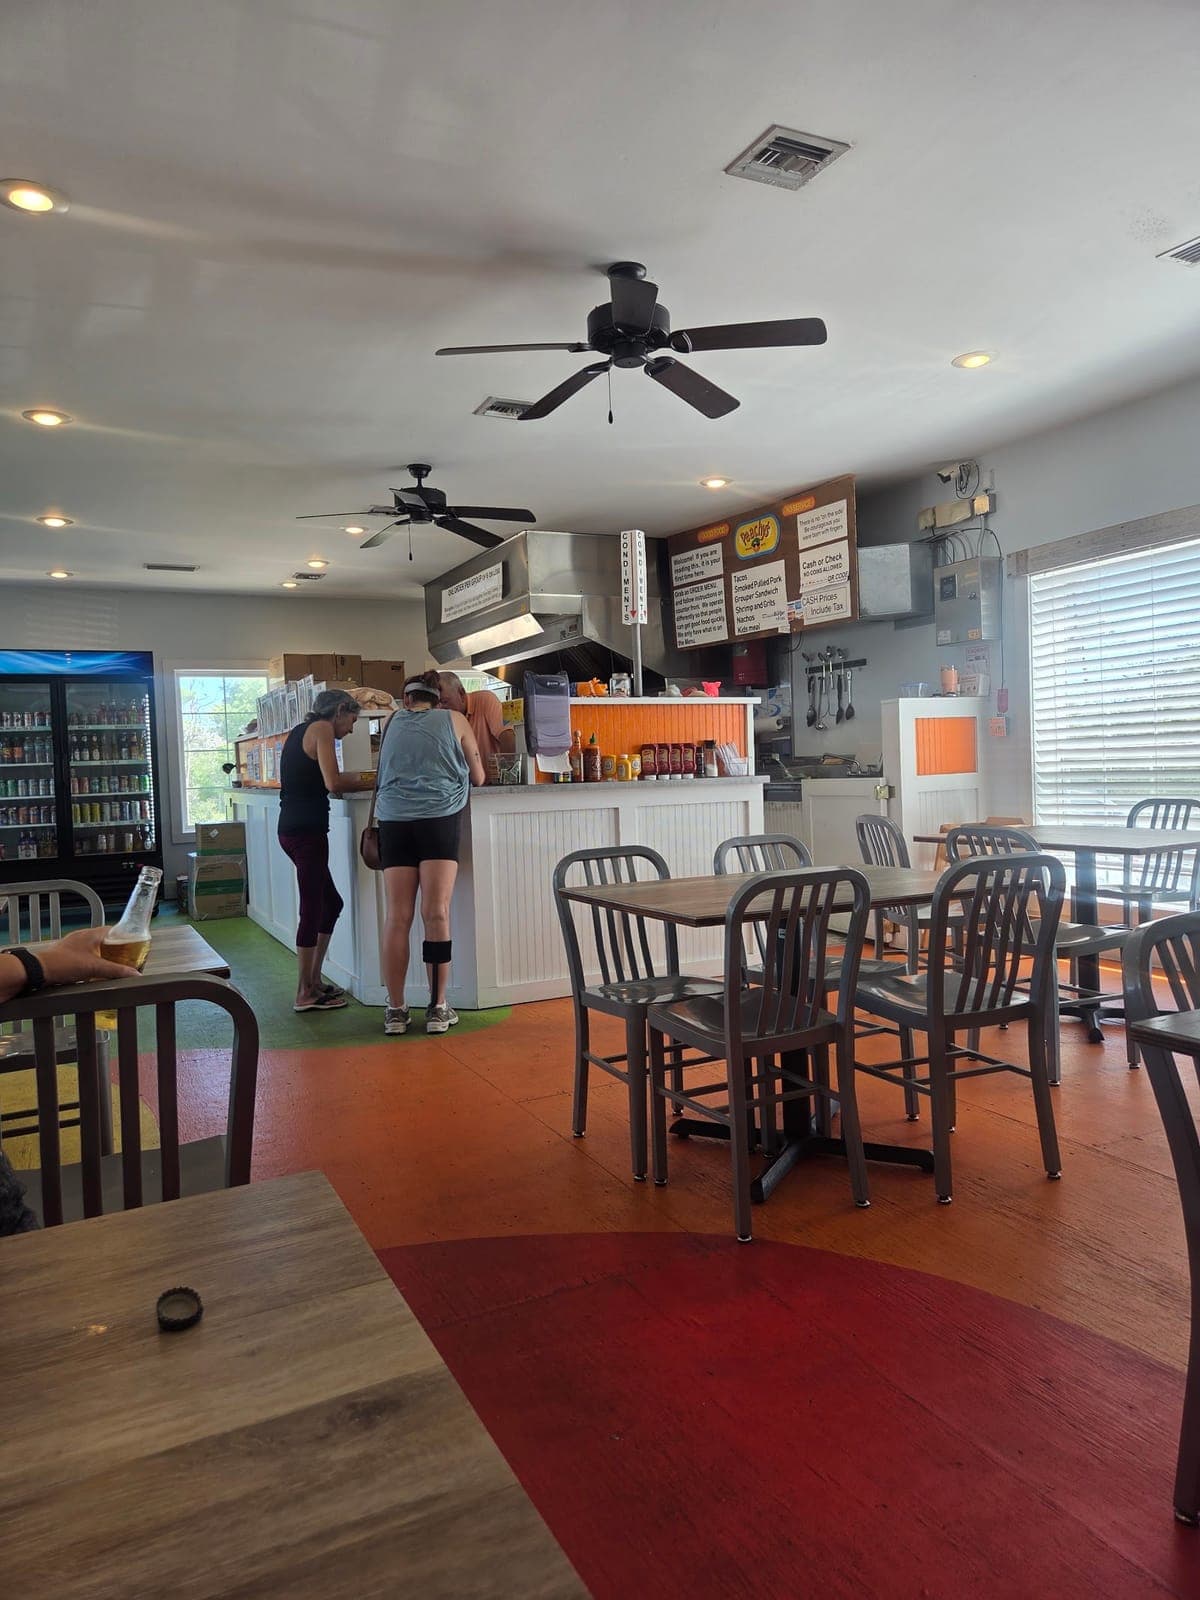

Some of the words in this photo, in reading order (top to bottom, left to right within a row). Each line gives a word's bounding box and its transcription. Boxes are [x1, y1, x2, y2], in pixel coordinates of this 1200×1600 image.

[802, 560, 817, 570] Cash
[825, 553, 842, 564] Check
[823, 562, 843, 572] ALLOWED
[734, 574, 748, 583] Tacos
[734, 583, 753, 593] Smoked
[754, 578, 769, 588] Pulled
[770, 574, 782, 584] Pork
[734, 593, 754, 603] Grouper
[755, 587, 778, 598] Sandwich
[802, 595, 818, 607] CASH
[819, 594, 838, 602] Prices
[735, 604, 753, 614] Shrimp
[764, 599, 776, 608] Grits
[811, 605, 832, 615] Include
[833, 603, 844, 611] Tax
[736, 614, 755, 624] Nachos
[737, 625, 748, 633] Kids
